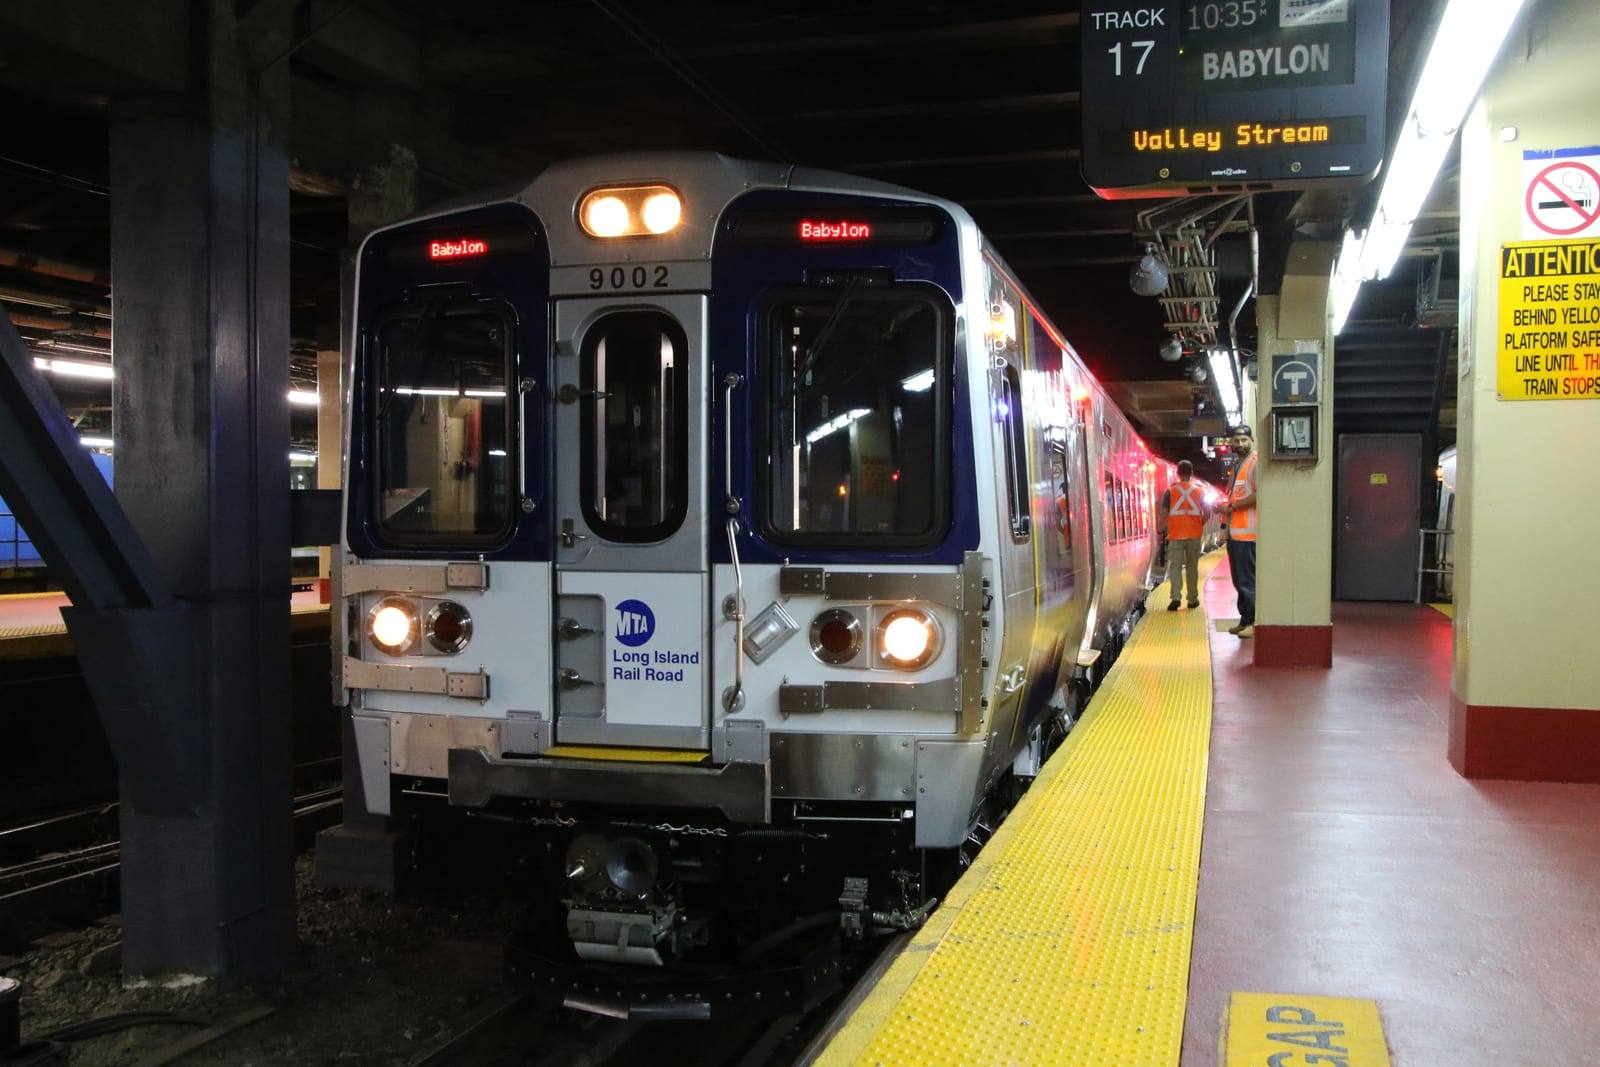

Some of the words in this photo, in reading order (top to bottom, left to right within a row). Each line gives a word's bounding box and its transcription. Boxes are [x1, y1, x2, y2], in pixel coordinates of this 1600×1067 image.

[1091, 8, 1165, 30] TRACK
[1188, 1, 1257, 30] 10:35
[1108, 40, 1155, 76] 17
[1203, 43, 1330, 80] BABYLON
[1134, 128, 1221, 151] Valley
[1237, 124, 1328, 145] Stream
[802, 222, 869, 237] Babylon
[431, 240, 484, 257] Babylon
[589, 265, 669, 290] 9002
[1523, 284, 1569, 303] PLEASE
[1574, 282, 1600, 300] STAY
[1513, 308, 1557, 326] BEHIND
[1562, 306, 1600, 324] YELLO
[1505, 331, 1567, 350] PLATFORM
[1515, 355, 1541, 373] LINE
[1545, 353, 1579, 372] UNTIL
[1523, 378, 1558, 396] TRAIN
[1563, 376, 1600, 395] STOPS
[613, 649, 650, 666] Long
[654, 650, 699, 665] Island
[613, 667, 641, 681] Rail
[645, 668, 684, 682] Road
